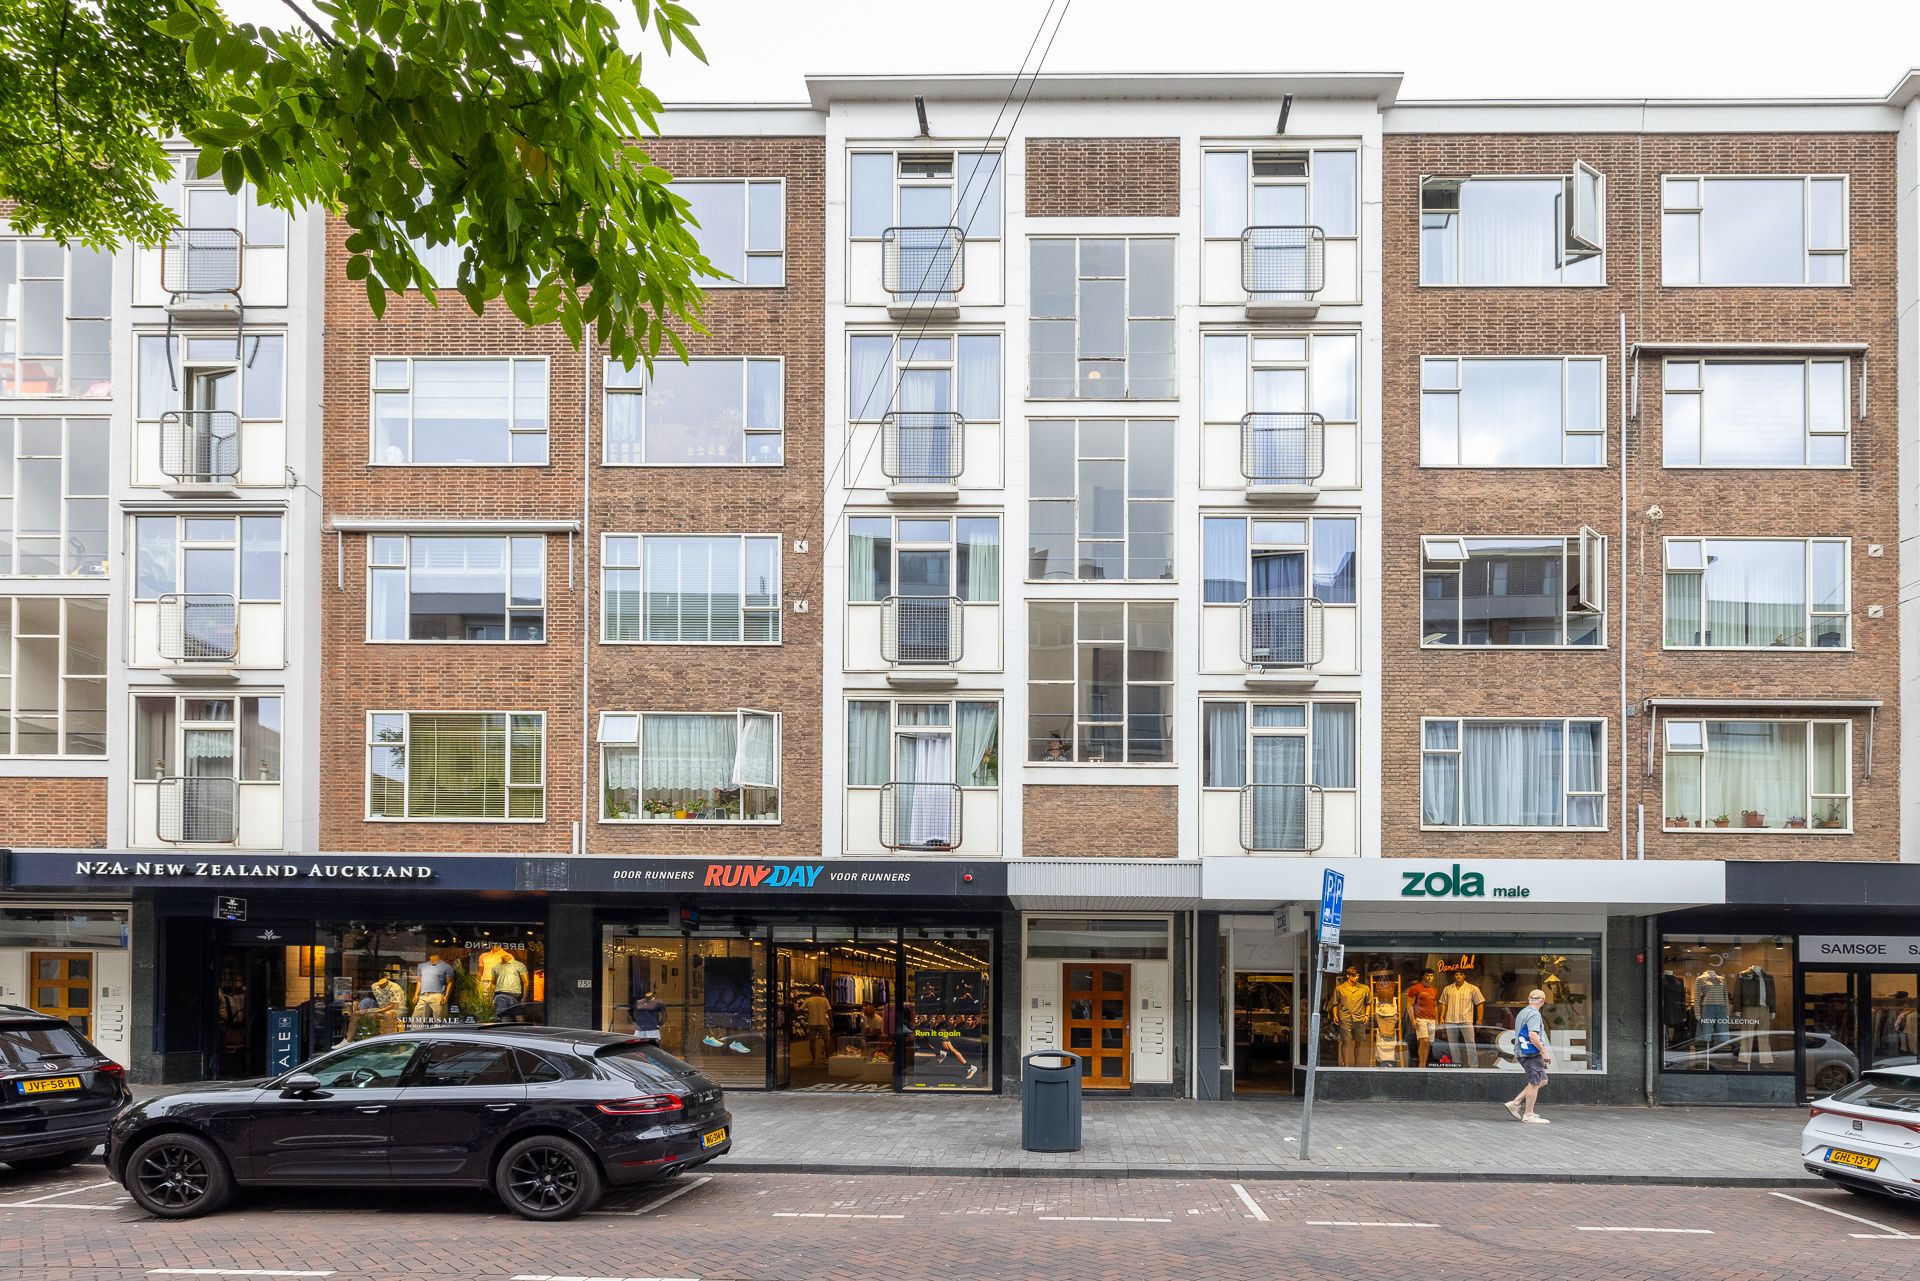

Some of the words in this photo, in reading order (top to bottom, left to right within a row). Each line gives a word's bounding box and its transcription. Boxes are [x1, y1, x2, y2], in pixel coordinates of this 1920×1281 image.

[135, 862, 185, 876] NEW
[195, 863, 298, 877] ZEALAND
[308, 864, 432, 878] AUCKLAND
[613, 870, 642, 879] DOOR
[644, 871, 695, 880] RUNNERS
[829, 872, 858, 881] VOOR
[861, 873, 911, 882] RUNNERS
[1401, 863, 1485, 897] zola
[1493, 885, 1530, 897] male
[1327, 875, 1334, 902] P
[1335, 878, 1343, 905] P
[1820, 943, 1887, 955] SAMSØE
[1908, 944, 1920, 955] S
[396, 1016, 434, 1024] SUMMER
[915, 1029, 930, 1037] Run
[931, 1029, 938, 1037] it
[938, 1029, 961, 1039] again
[278, 1031, 291, 1076] ALE
[28, 1079, 76, 1091] JVF-58-H
[1833, 1151, 1874, 1167] GHL-13-V
